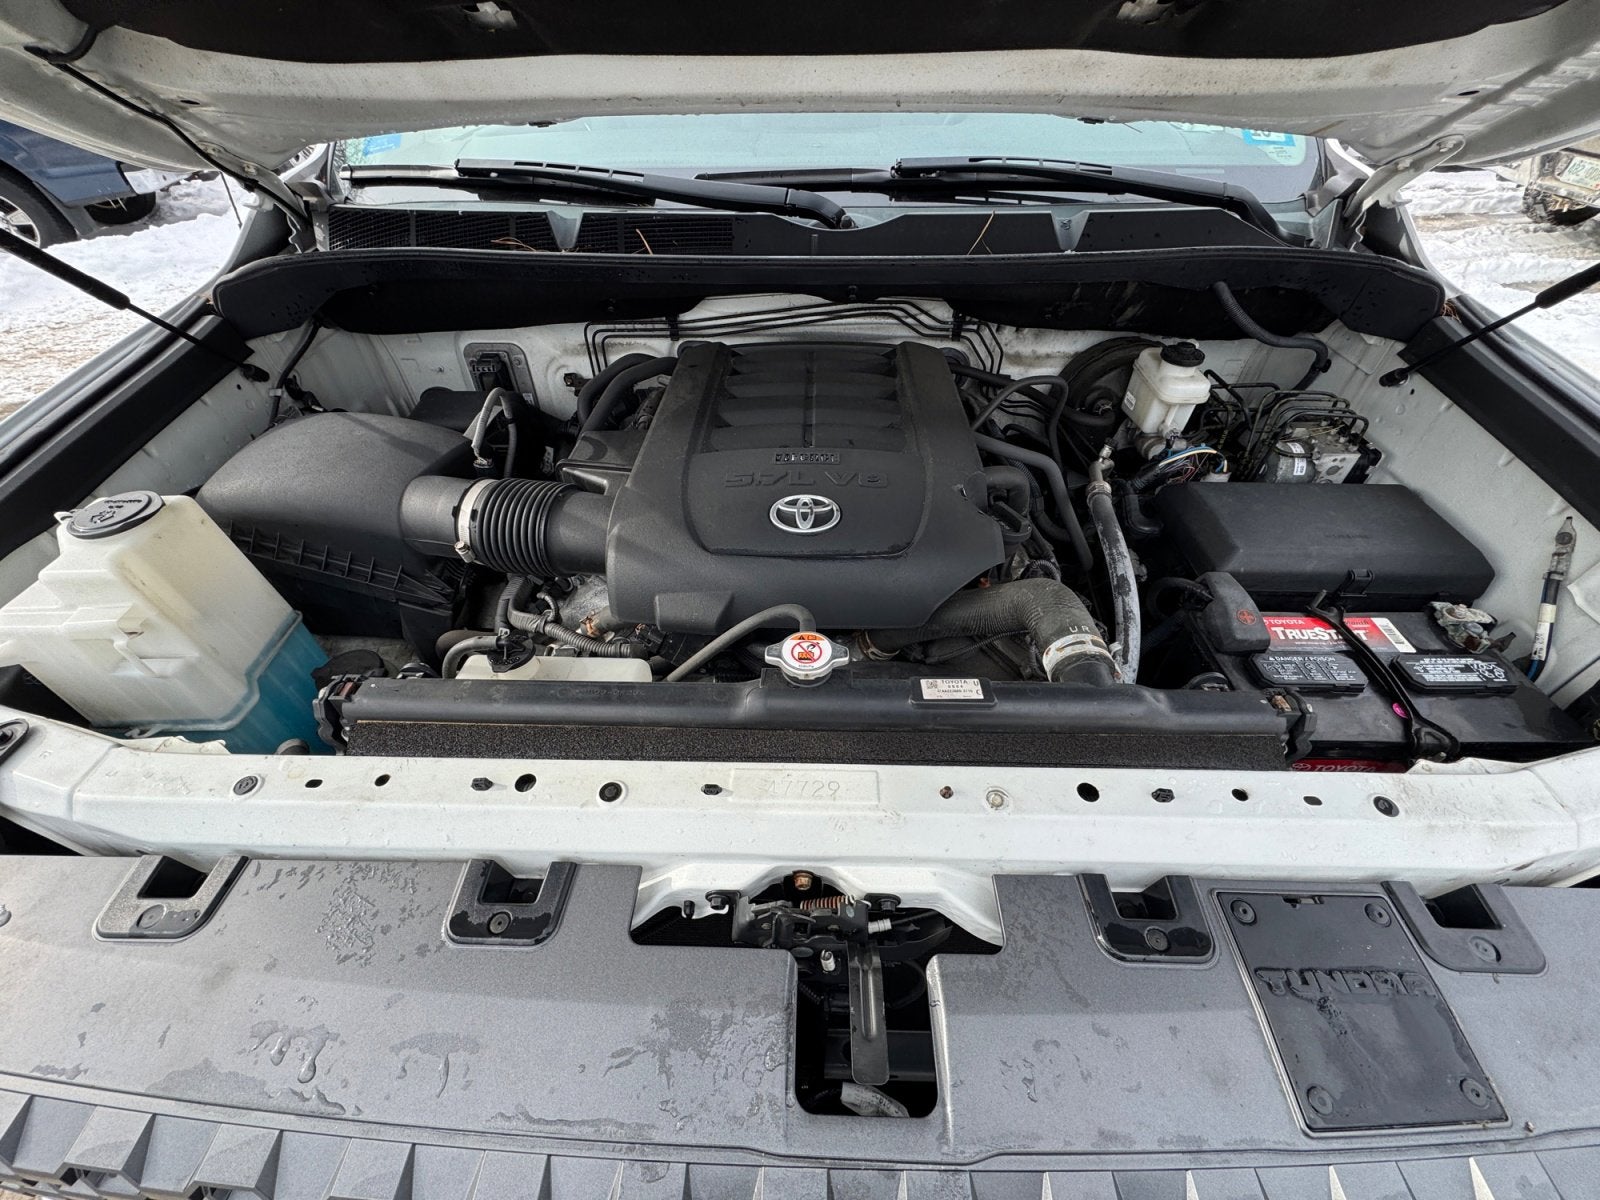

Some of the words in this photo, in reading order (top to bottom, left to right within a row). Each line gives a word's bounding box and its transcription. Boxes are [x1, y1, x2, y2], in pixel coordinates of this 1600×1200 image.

[824, 471, 888, 488] V8
[1271, 626, 1368, 641] TRUESTT
[1313, 764, 1377, 772] TOYOTA
[1255, 967, 1437, 999] TUNDRA
